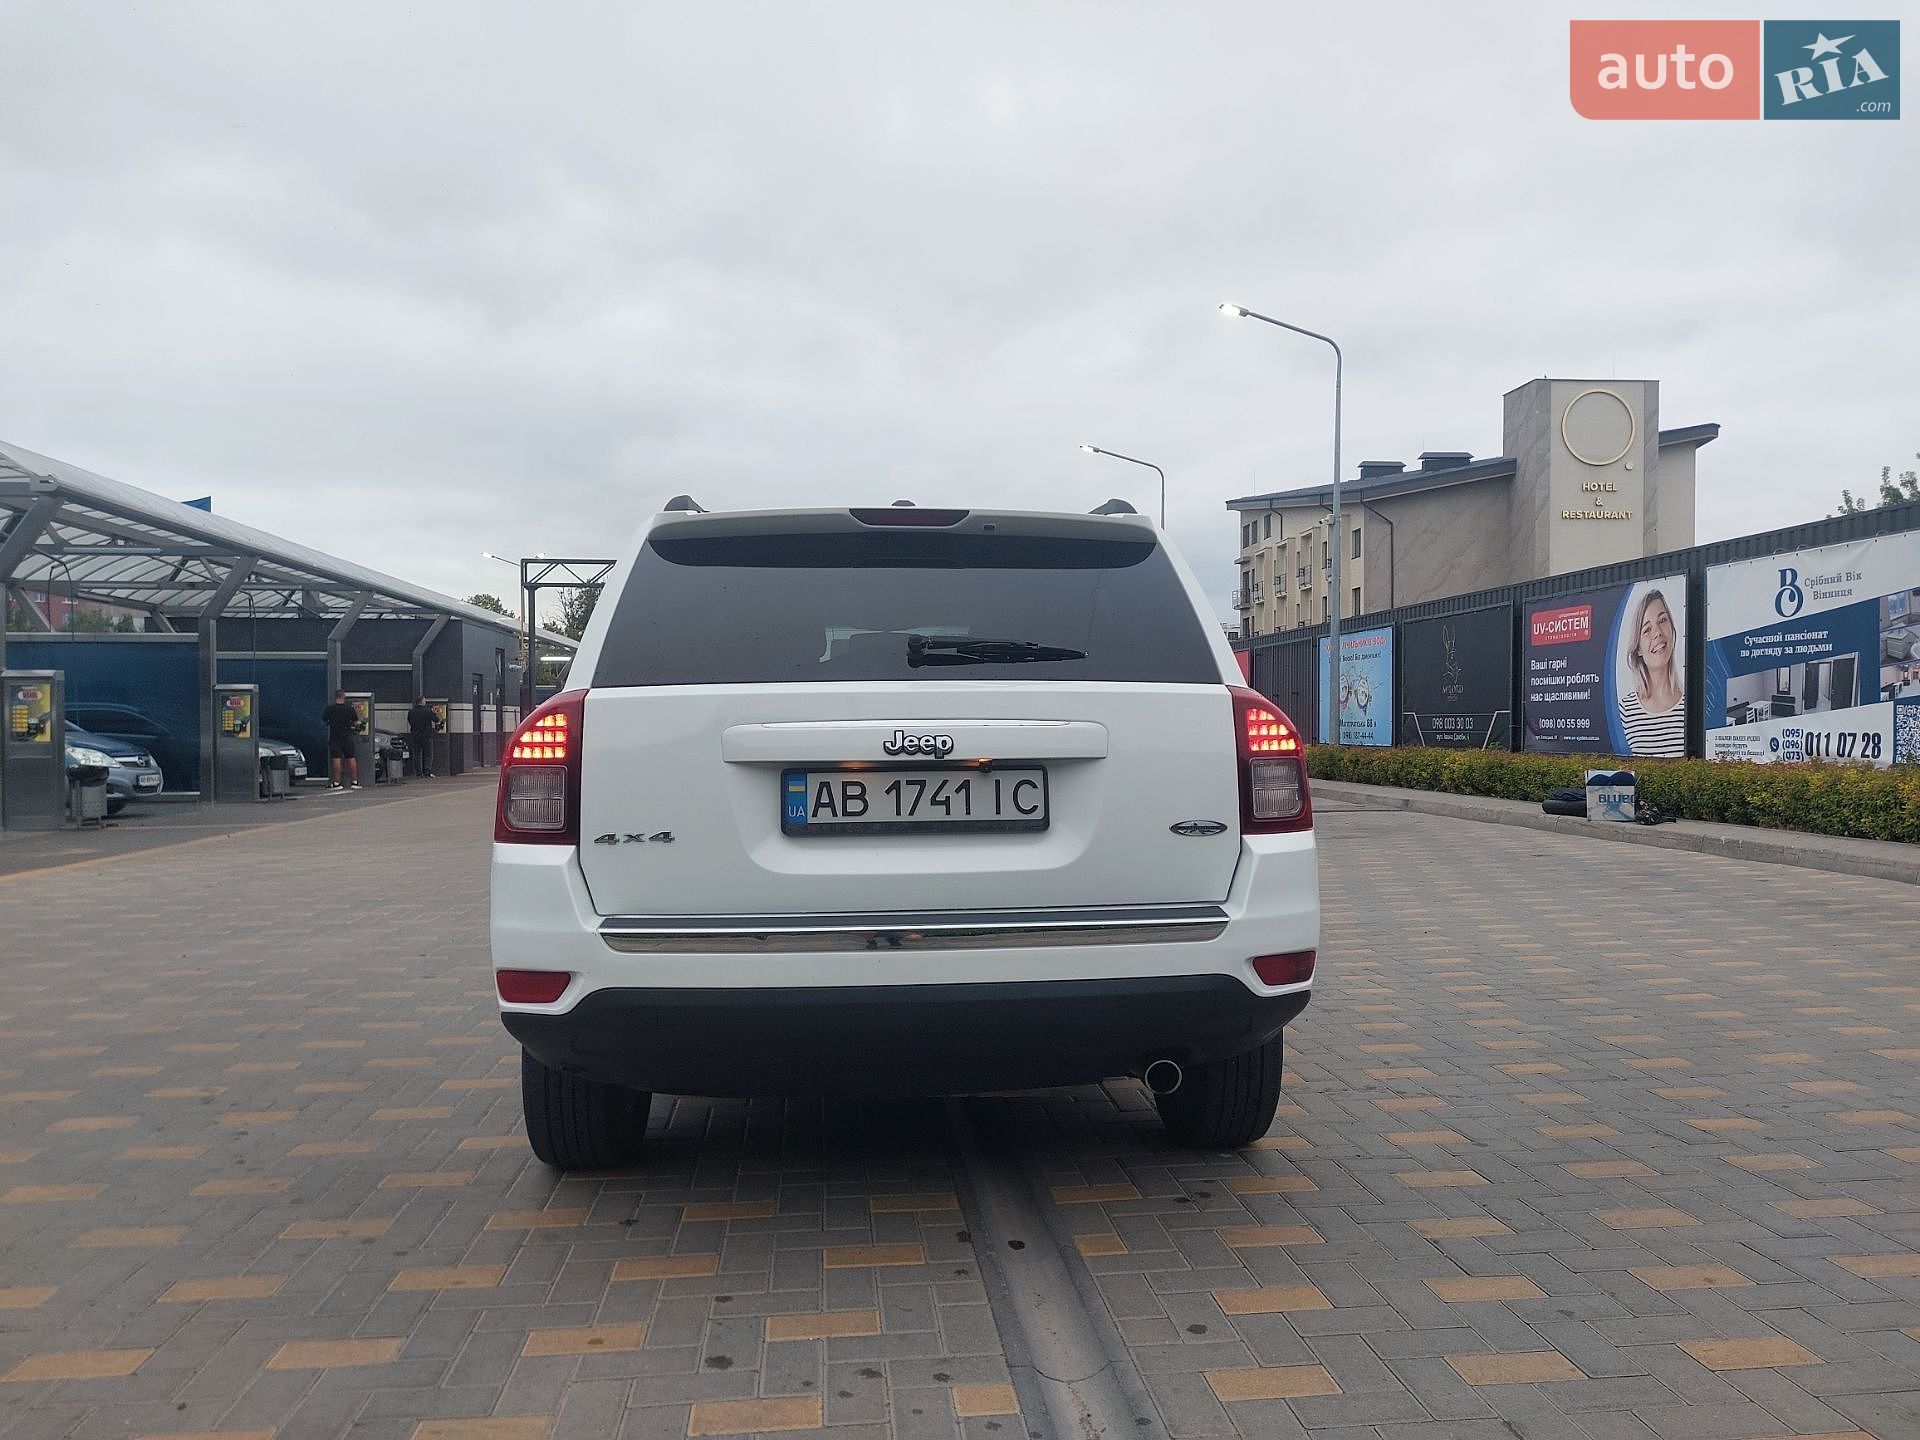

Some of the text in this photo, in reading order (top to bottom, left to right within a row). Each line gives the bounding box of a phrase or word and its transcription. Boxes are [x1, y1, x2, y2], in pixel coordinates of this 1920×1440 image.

[1582, 482, 1618, 492] HOTEL
[1595, 496, 1604, 507] &
[1562, 510, 1633, 520] RESTAURANT
[1804, 571, 1863, 589] Срібний Вік
[1813, 589, 1853, 600] Вінниця
[1533, 616, 1589, 635] UV-СИСТЕМ
[1785, 629, 1829, 641] пансіонат
[1740, 642, 1833, 659] по догляду за людьми
[1531, 656, 1568, 671] Ваші гарні
[1531, 673, 1600, 687] посмішки роблять
[1531, 688, 1591, 703] нас щасливими!
[1566, 719, 1576, 729] 55
[1782, 728, 1804, 739] (095)
[883, 730, 954, 759] Jeep
[1782, 740, 1804, 751] (096)
[1805, 732, 1882, 759] 011 07 28
[1782, 751, 1804, 762] (073)
[811, 779, 1039, 818] AB 1741 IC
[788, 806, 806, 818] UA
